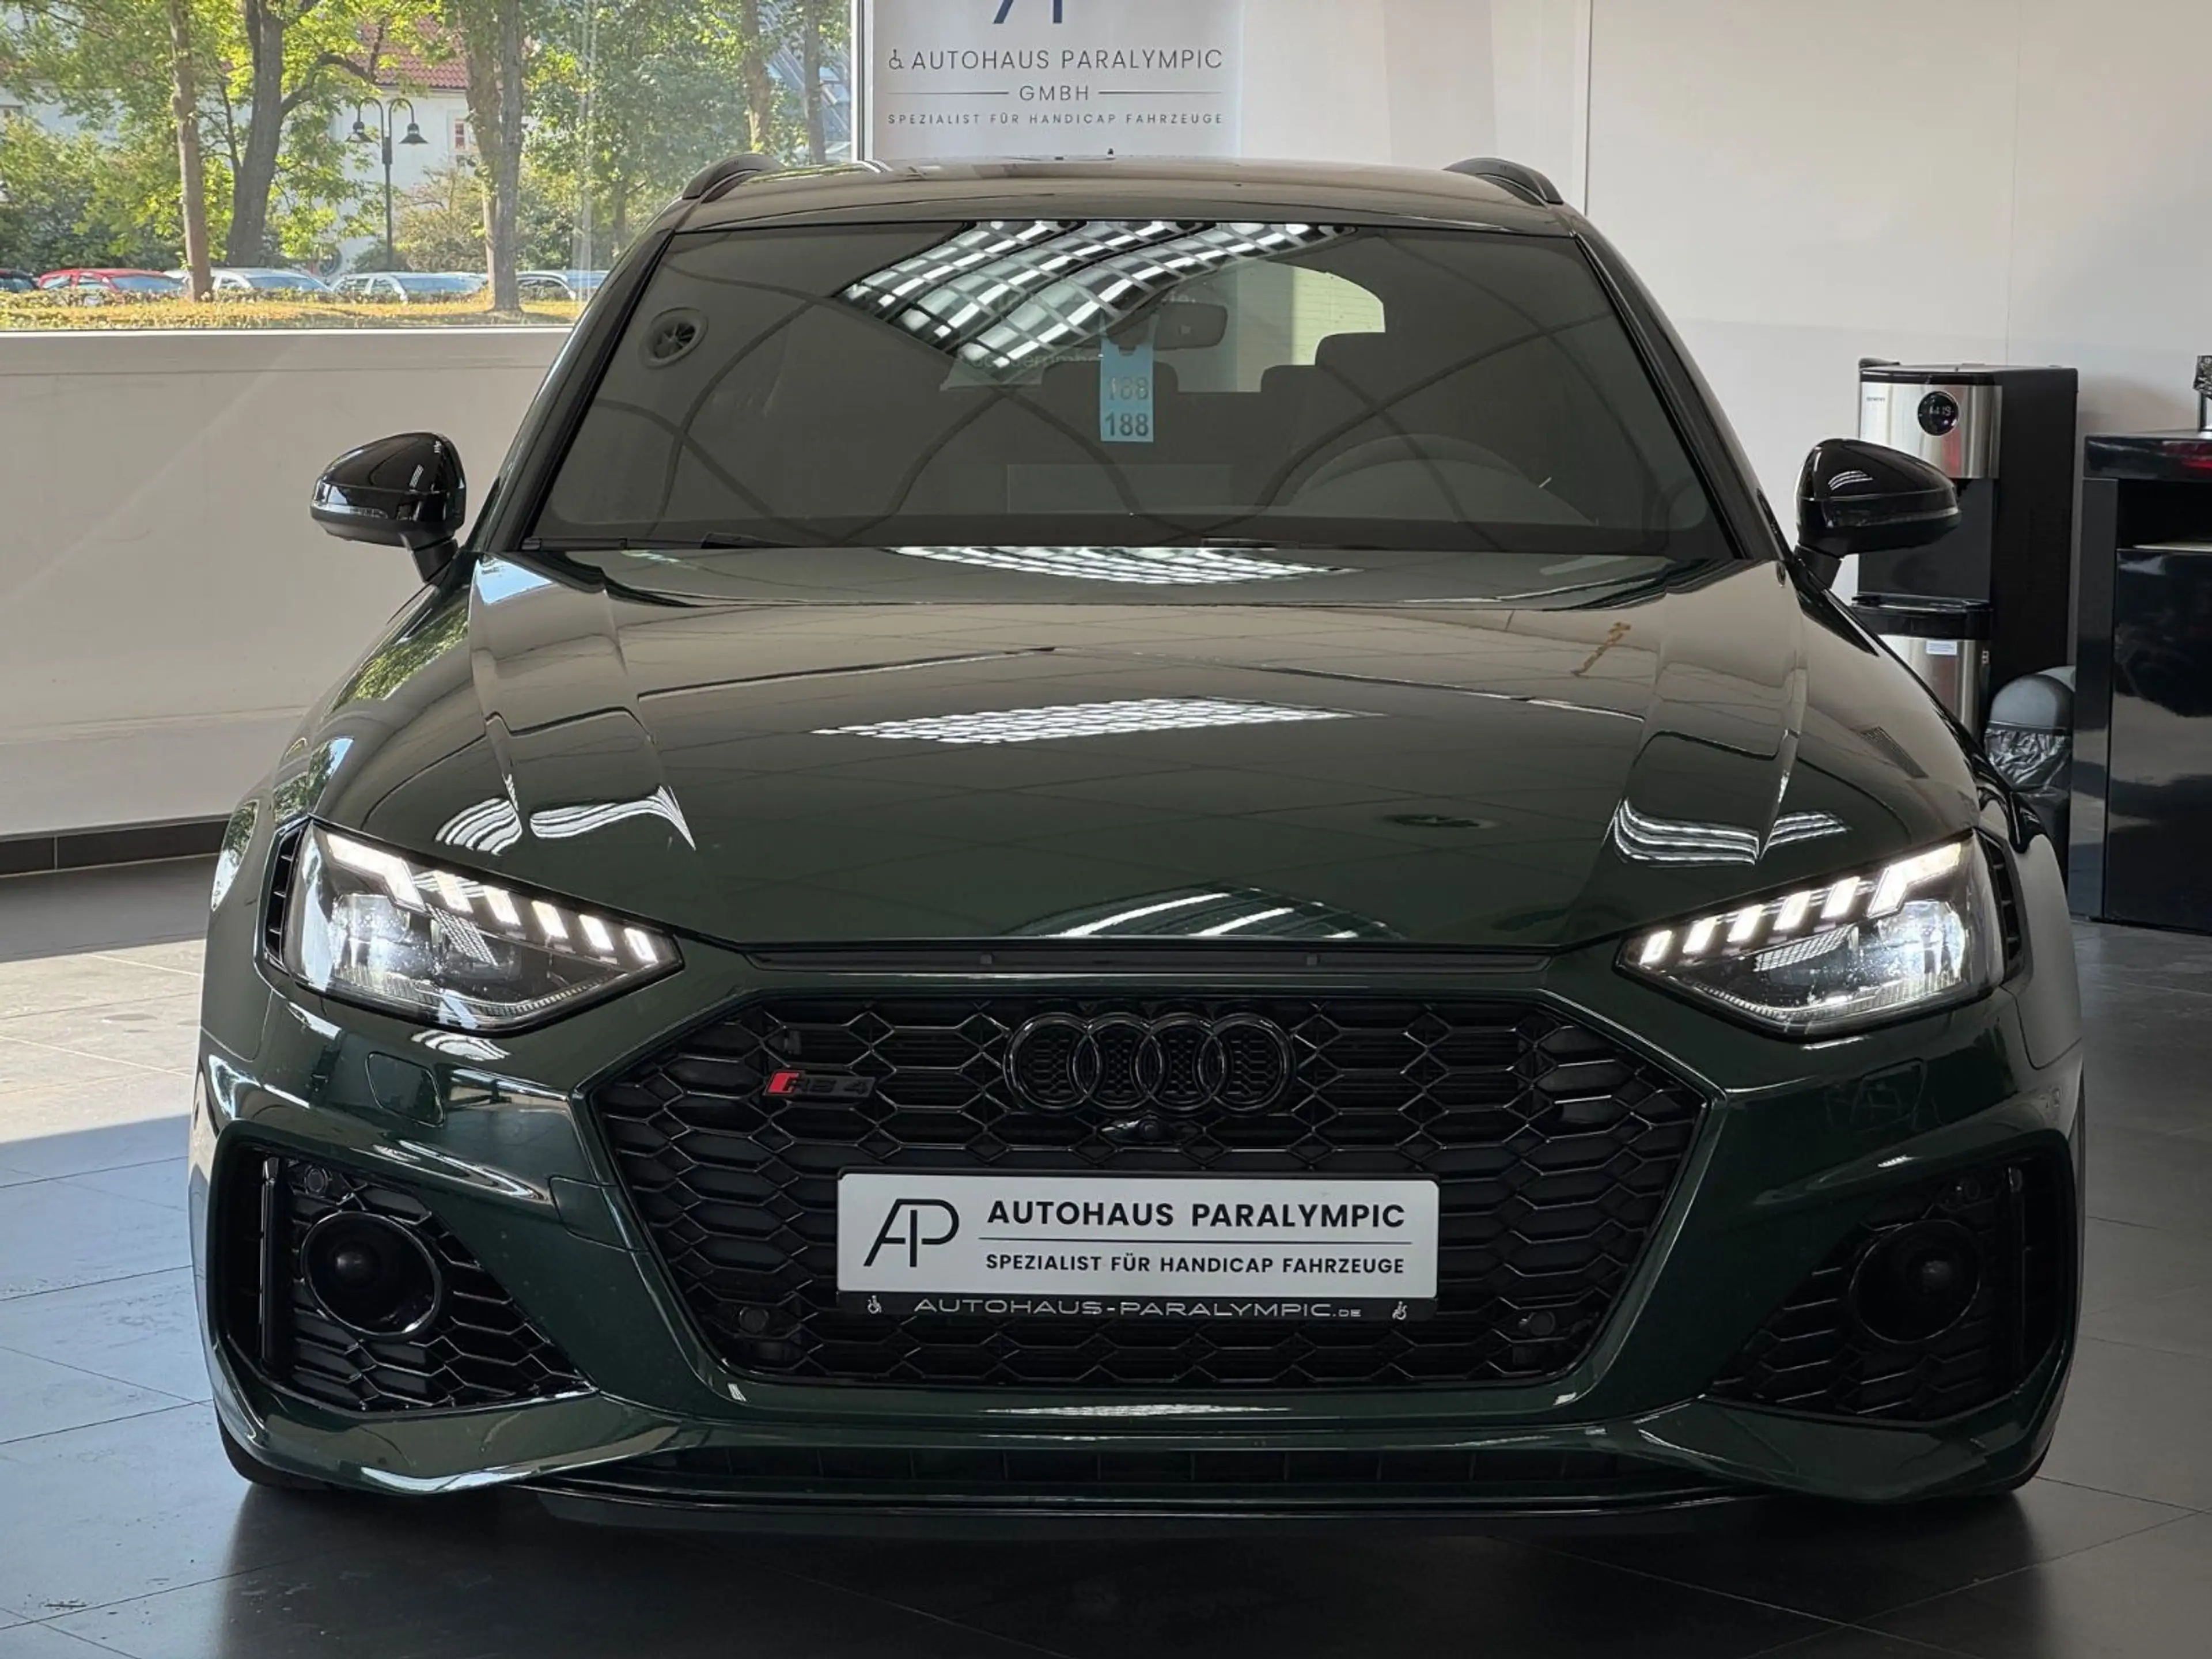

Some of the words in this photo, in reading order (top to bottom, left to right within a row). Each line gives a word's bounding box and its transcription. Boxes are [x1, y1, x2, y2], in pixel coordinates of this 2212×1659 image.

[911, 50, 1049, 70] AUTOHAUS
[1062, 49, 1222, 69] PARALYMPIC
[1019, 85, 1089, 101] GMBH
[888, 113, 979, 124] SPEZIALIST
[990, 112, 1018, 124] FÜR
[1029, 113, 1116, 124] HANDICAP
[1126, 113, 1222, 124] FAHRZEUGE
[1105, 411, 1149, 437] 188
[987, 1200, 1173, 1227] AUTOHAUS
[1192, 1203, 1404, 1228] PARALYMPIC
[986, 1253, 1102, 1272] SPEZIALIST
[1111, 1252, 1150, 1272] FÜR
[1160, 1256, 1273, 1274] HANDICAP
[1283, 1257, 1404, 1274] FAHRZEUGE
